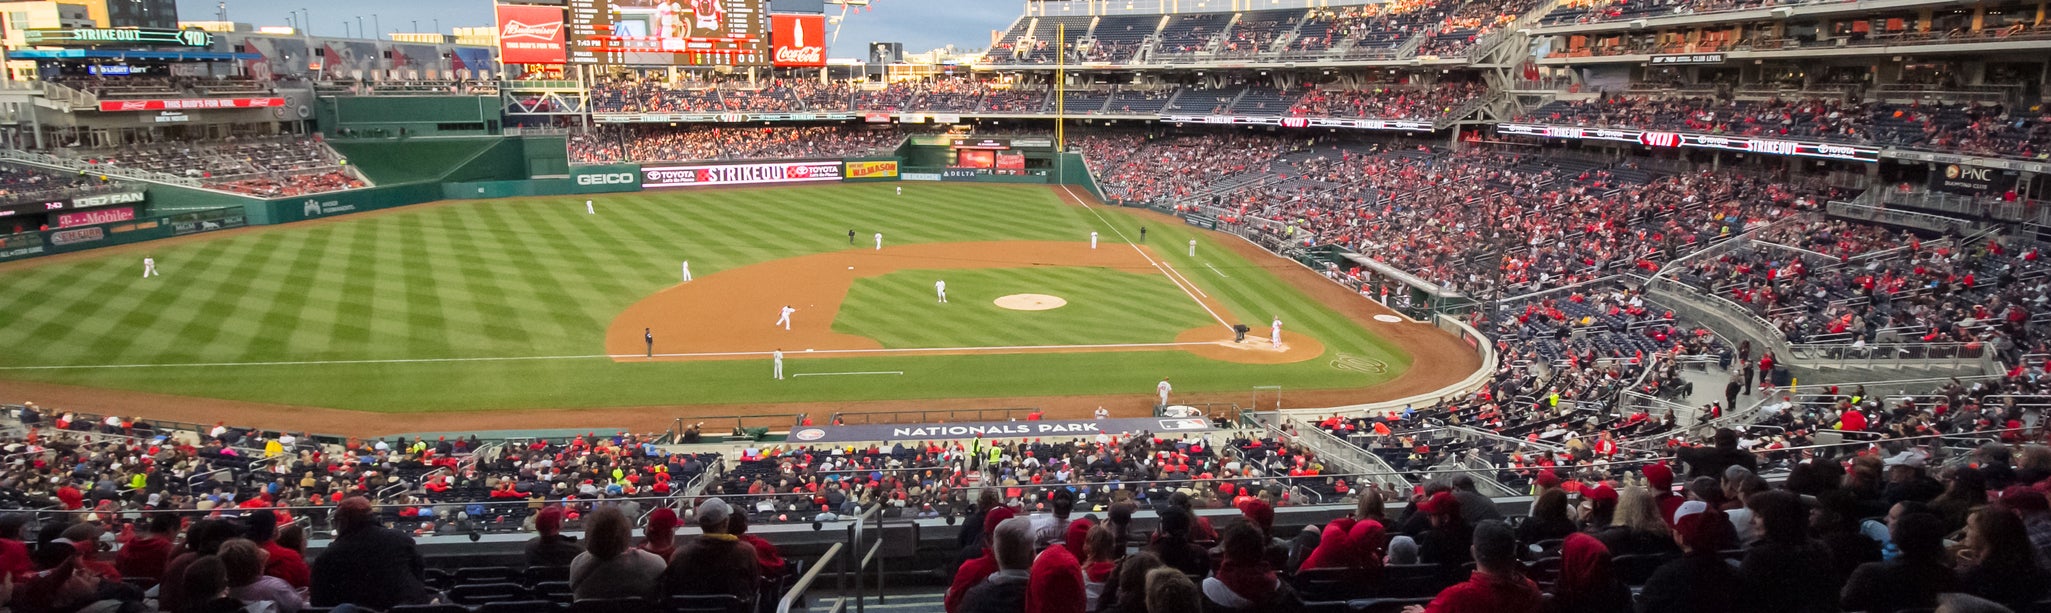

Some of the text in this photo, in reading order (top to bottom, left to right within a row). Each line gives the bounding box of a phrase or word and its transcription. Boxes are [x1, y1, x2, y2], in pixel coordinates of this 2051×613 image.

[73, 29, 141, 41] STRIKEOUT
[507, 24, 557, 35] Budweiser
[776, 45, 822, 62] Coca-Cola
[1547, 128, 1584, 138] STRIKEOUT
[1747, 140, 1798, 154] STRIKEOUT
[1828, 146, 1855, 154] TOYOTA
[577, 172, 634, 185] GEICO
[708, 165, 788, 181] STRIKEOUT
[1961, 168, 1992, 182] PNC
[111, 192, 145, 204] FAN
[893, 422, 1100, 437] NATIONALS PARK
